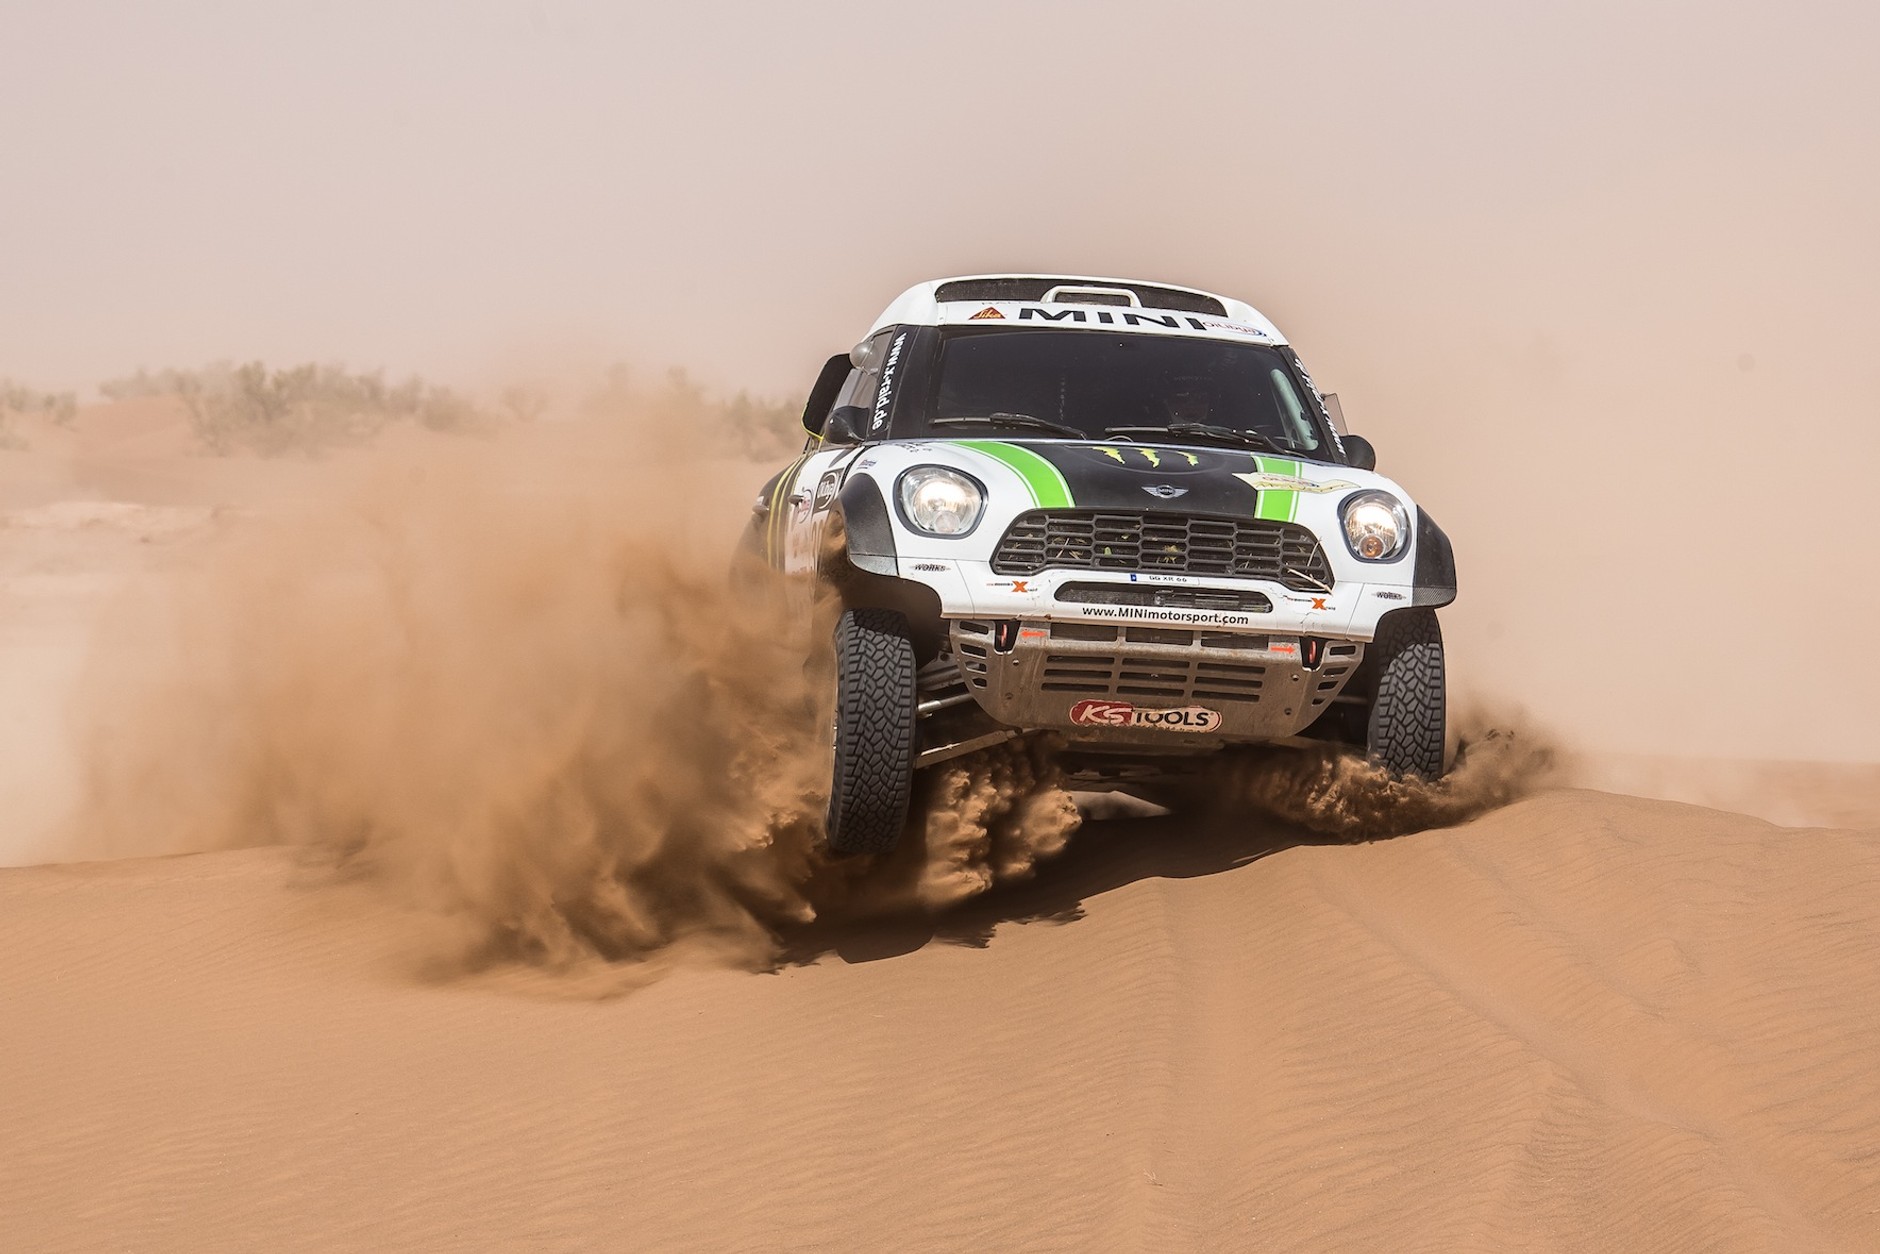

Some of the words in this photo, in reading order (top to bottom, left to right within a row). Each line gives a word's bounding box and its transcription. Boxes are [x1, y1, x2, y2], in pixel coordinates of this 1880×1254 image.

[1019, 308, 1206, 330] MINI
[872, 332, 907, 430] www.x-raid.de
[1080, 704, 1133, 724] KS
[1135, 711, 1209, 726] TOOLS
